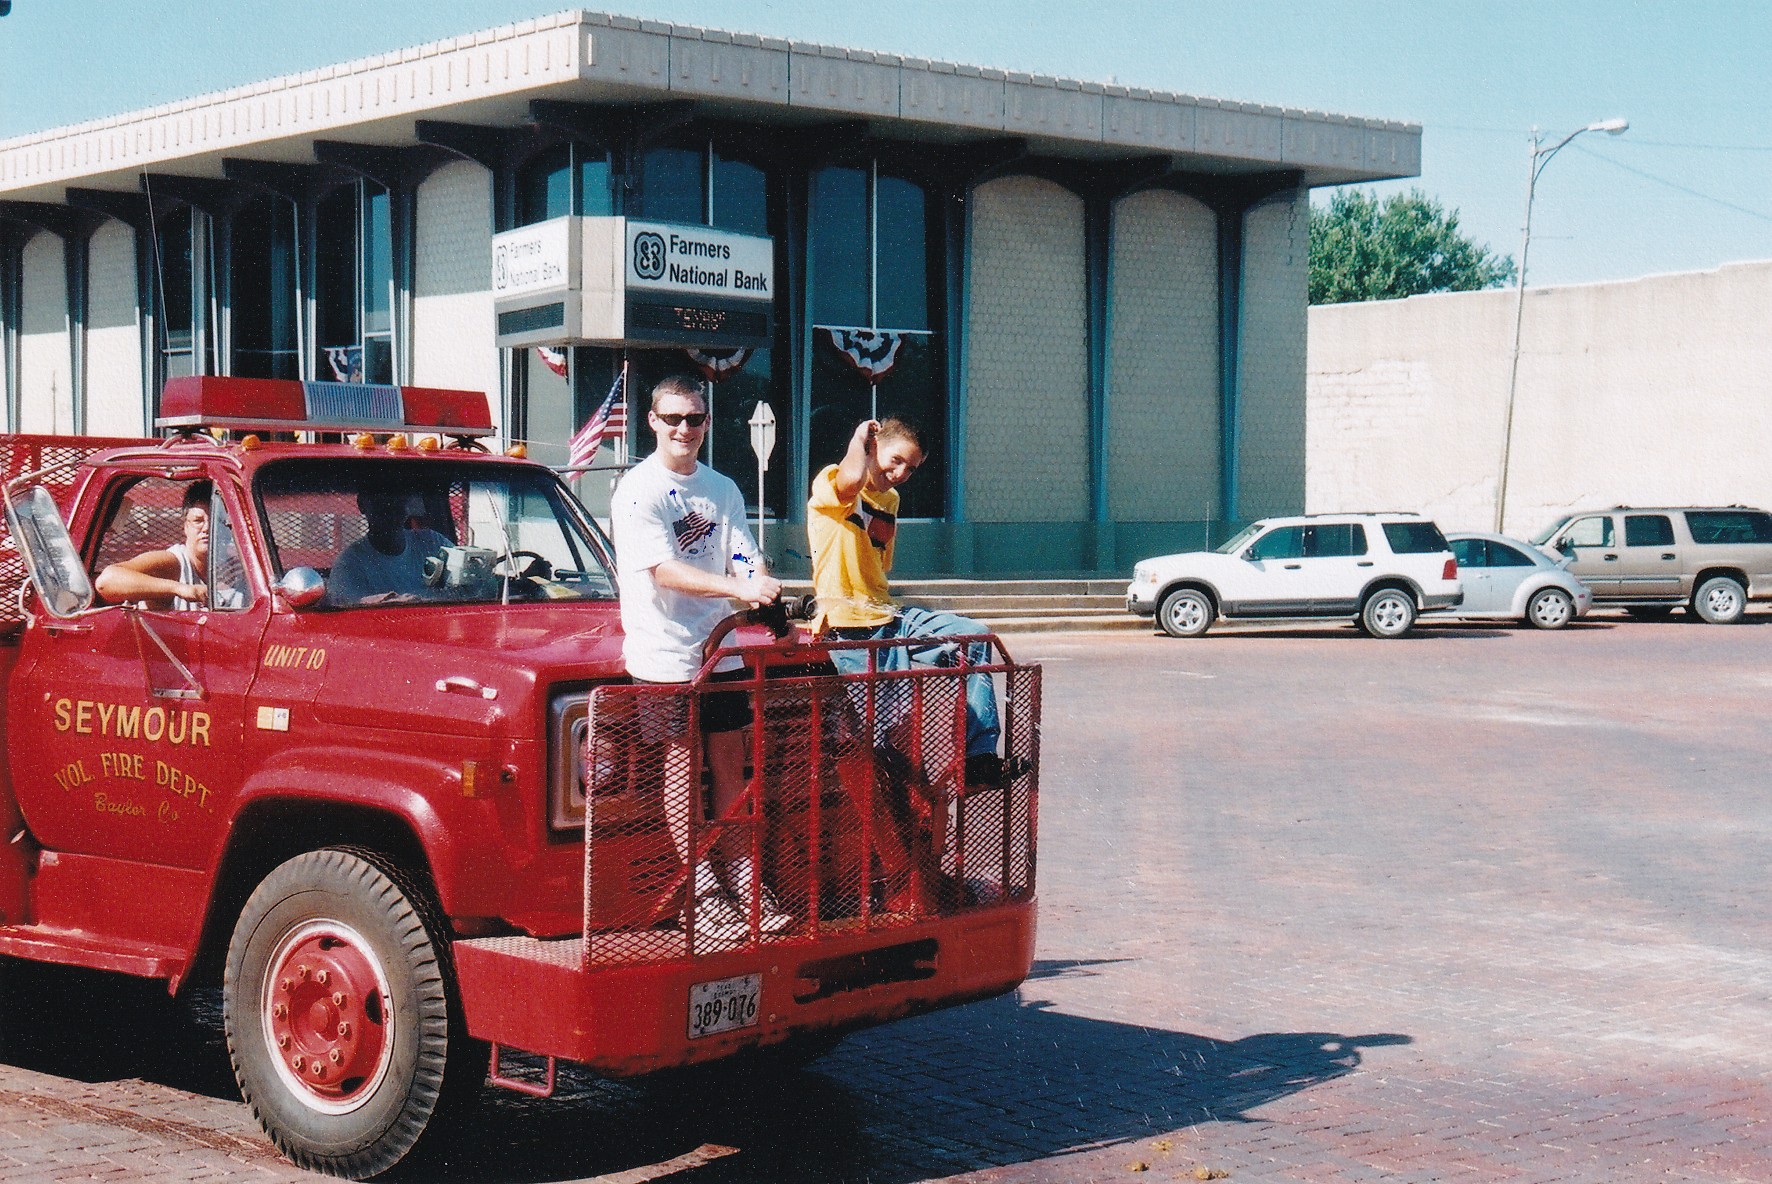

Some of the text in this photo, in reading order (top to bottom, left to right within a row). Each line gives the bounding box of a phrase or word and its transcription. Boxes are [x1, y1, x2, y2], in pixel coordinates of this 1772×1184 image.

[670, 234, 731, 260] Farmers
[669, 262, 767, 291] National Bank
[263, 644, 326, 670] UNIT 10
[54, 698, 212, 747] SEYMOUR
[100, 752, 145, 780] FIRE
[156, 760, 213, 814] DEPT.
[94, 792, 147, 816] Baylor
